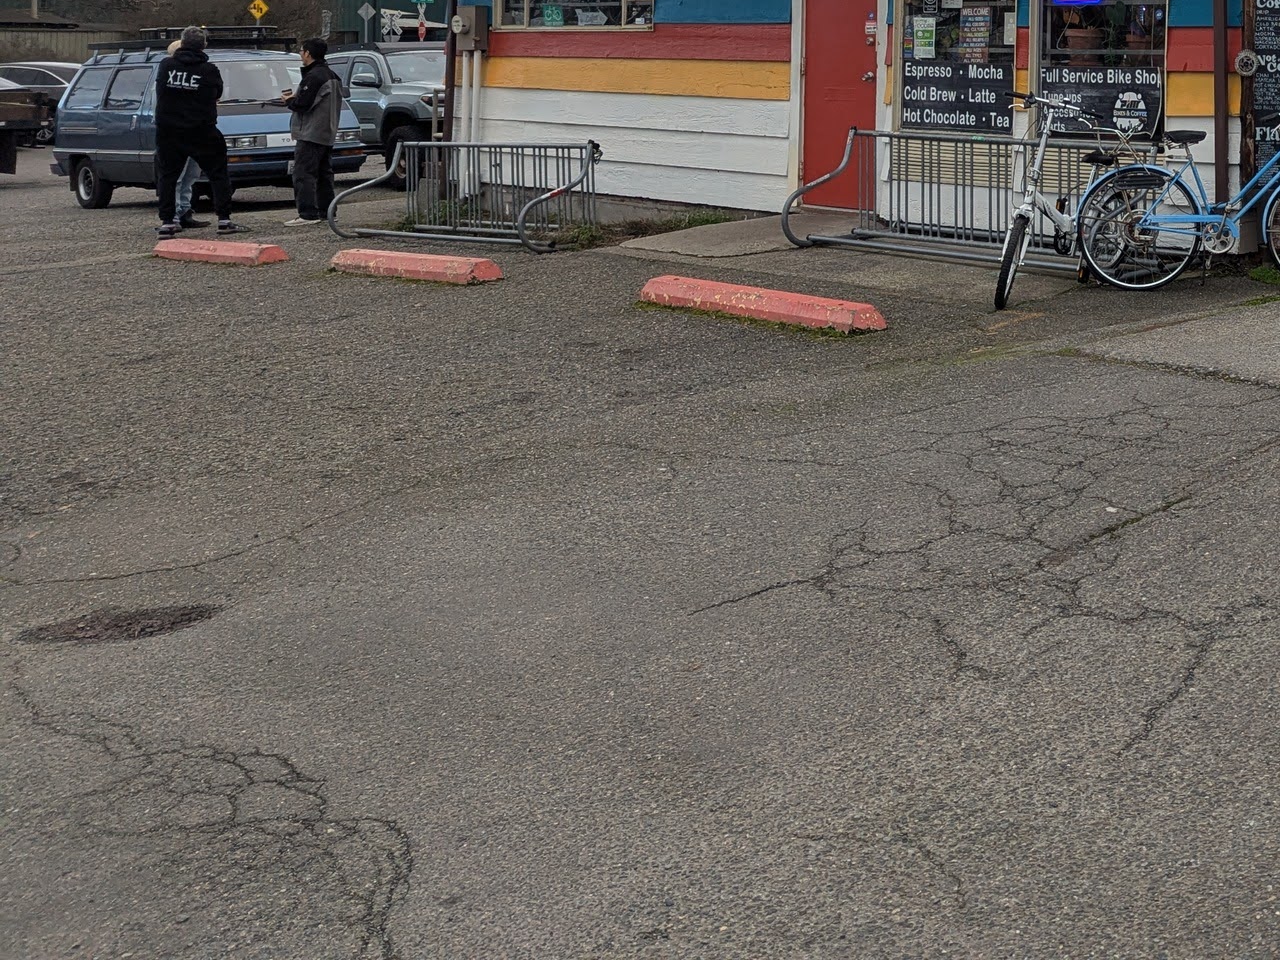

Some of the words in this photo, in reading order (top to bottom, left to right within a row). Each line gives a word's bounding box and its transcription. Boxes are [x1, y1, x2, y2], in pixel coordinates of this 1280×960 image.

[962, 8, 988, 16] WELCOME
[1257, 54, 1276, 66] Not
[166, 70, 202, 87] XILE
[904, 62, 952, 80] Espresso
[968, 64, 1003, 79] Mocha
[1041, 69, 1059, 83] Full
[1062, 69, 1103, 83] Service
[1107, 69, 1132, 84] Bike
[904, 86, 926, 100] Cold
[930, 87, 956, 101] Brew
[968, 88, 996, 103] Latte
[903, 108, 920, 122] Hot
[924, 109, 976, 125] Chocolate
[990, 112, 1010, 127] Tea
[1043, 121, 1066, 131] arts
